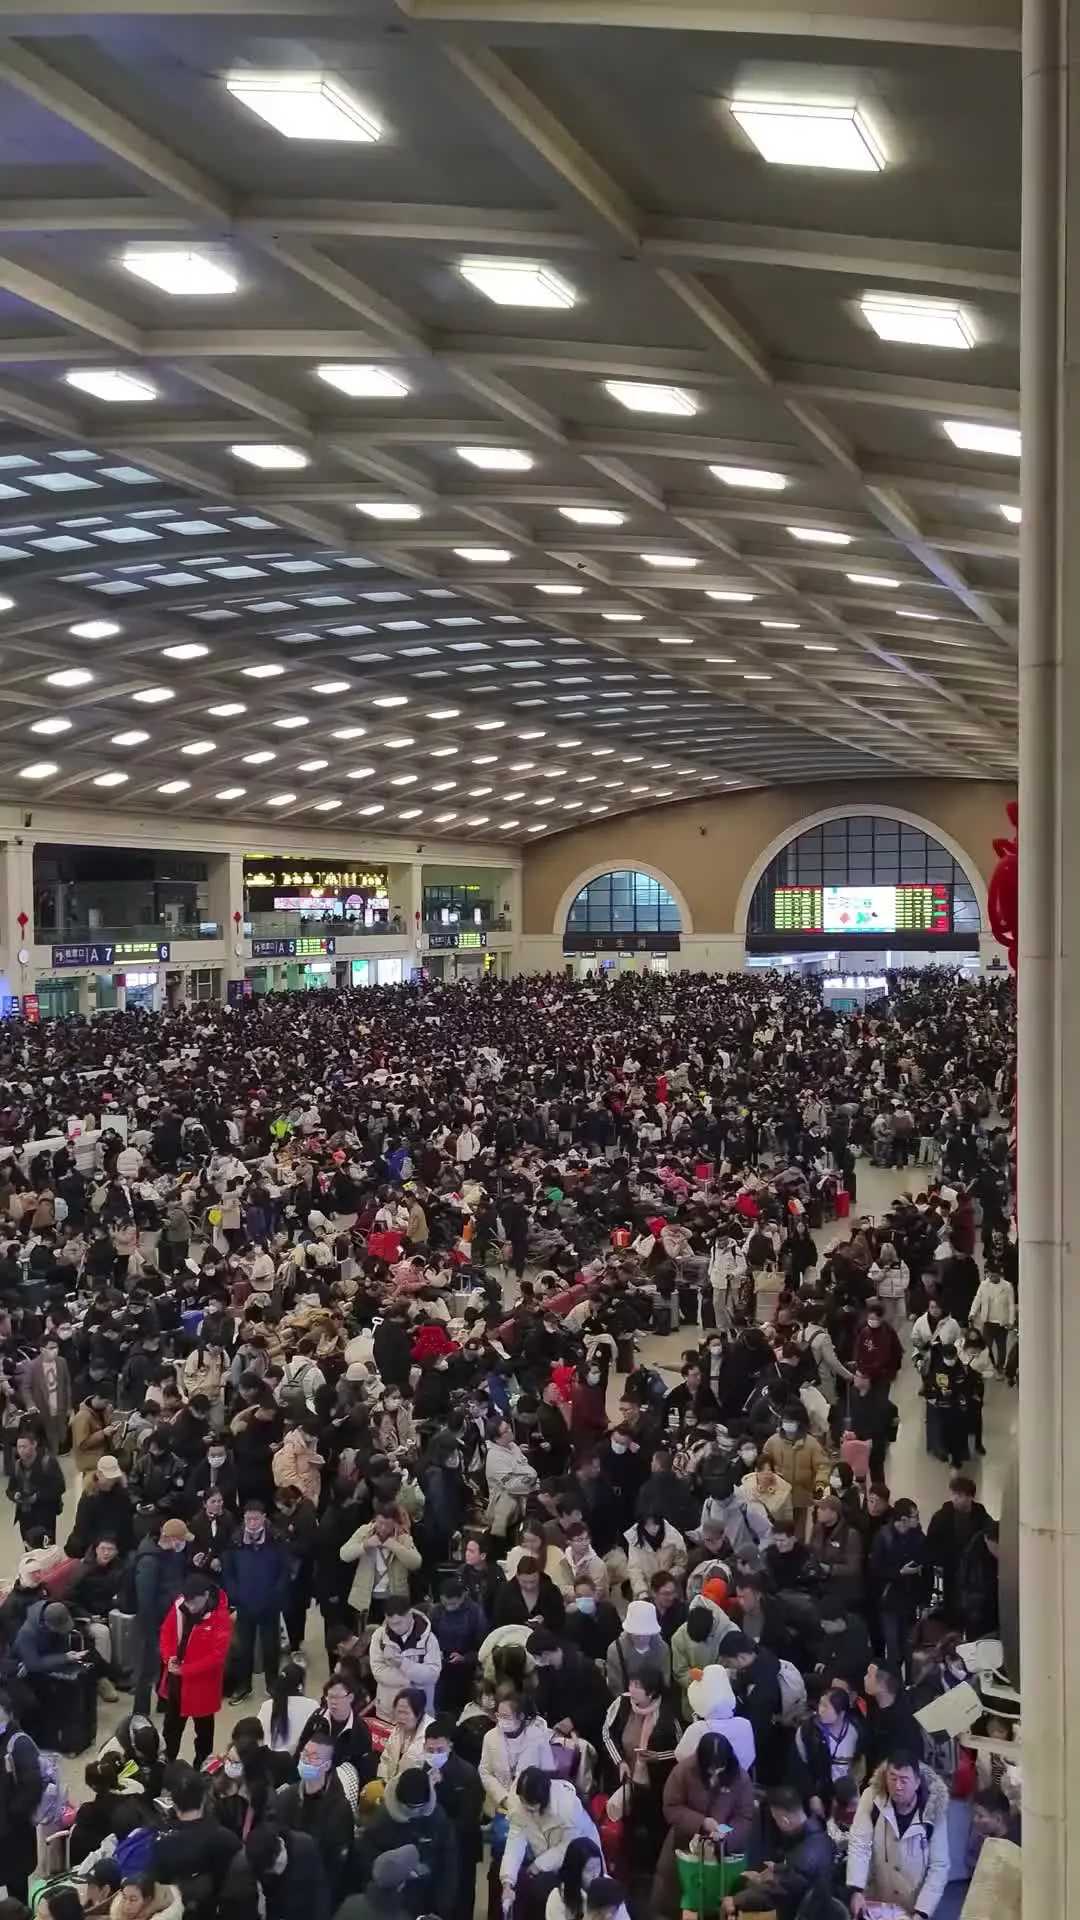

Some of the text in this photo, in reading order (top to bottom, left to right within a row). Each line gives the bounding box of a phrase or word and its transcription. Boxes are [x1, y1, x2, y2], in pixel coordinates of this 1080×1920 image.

[481, 935, 486, 944] 2
[279, 943, 285, 953] A
[289, 942, 294, 953] 5
[329, 941, 333, 951] 4
[91, 948, 99, 961] A
[105, 948, 112, 961] 7
[161, 946, 168, 959] 6
